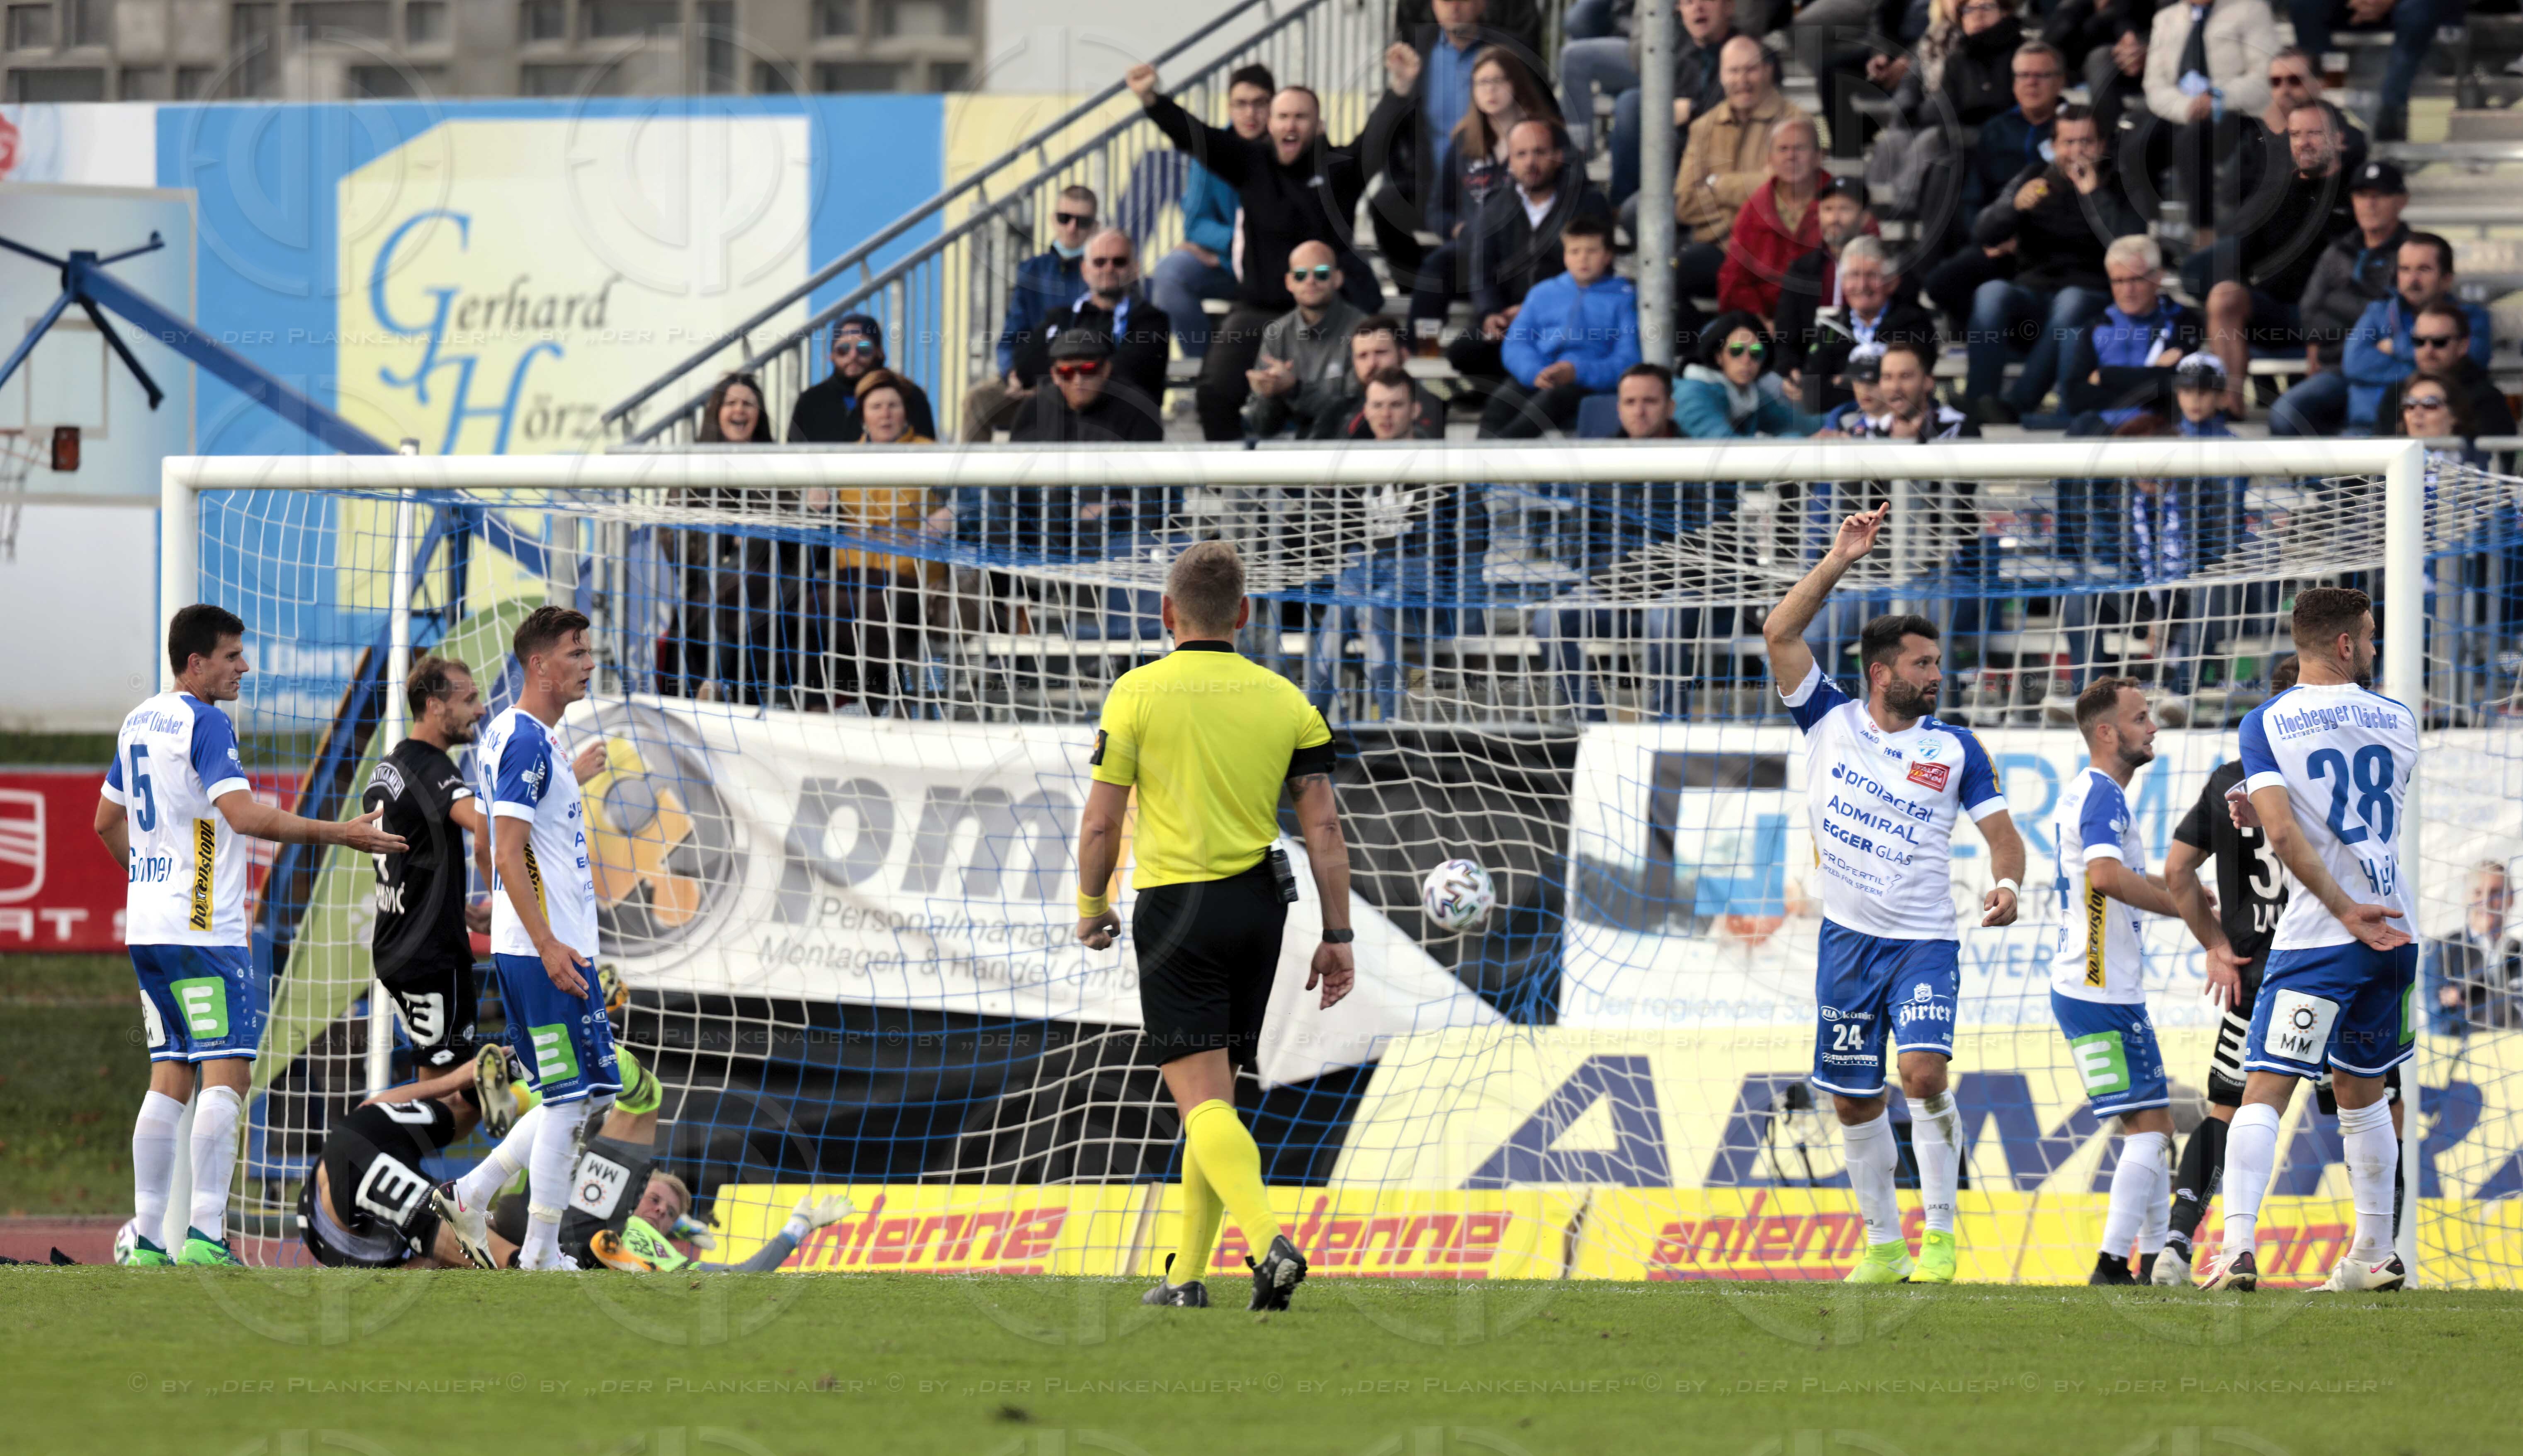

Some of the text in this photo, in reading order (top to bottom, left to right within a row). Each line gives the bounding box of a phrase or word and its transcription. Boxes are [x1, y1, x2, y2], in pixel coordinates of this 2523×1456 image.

[367, 209, 624, 404] Gerhard
[2273, 706, 2350, 735] Hochegger
[130, 745, 156, 832] 5
[1845, 770, 1933, 823] prolactal
[2307, 744, 2394, 845] 28
[1823, 818, 1913, 865] EGGER GLAS
[1827, 795, 1919, 845] ADMIRAL
[771, 776, 1077, 924] pm
[758, 935, 909, 973] Montagen
[920, 953, 939, 977] &
[949, 954, 1057, 986] Handel
[1822, 1009, 1838, 1019] KIA
[1833, 1024, 1864, 1051] 24
[2280, 1033, 2313, 1055] MM
